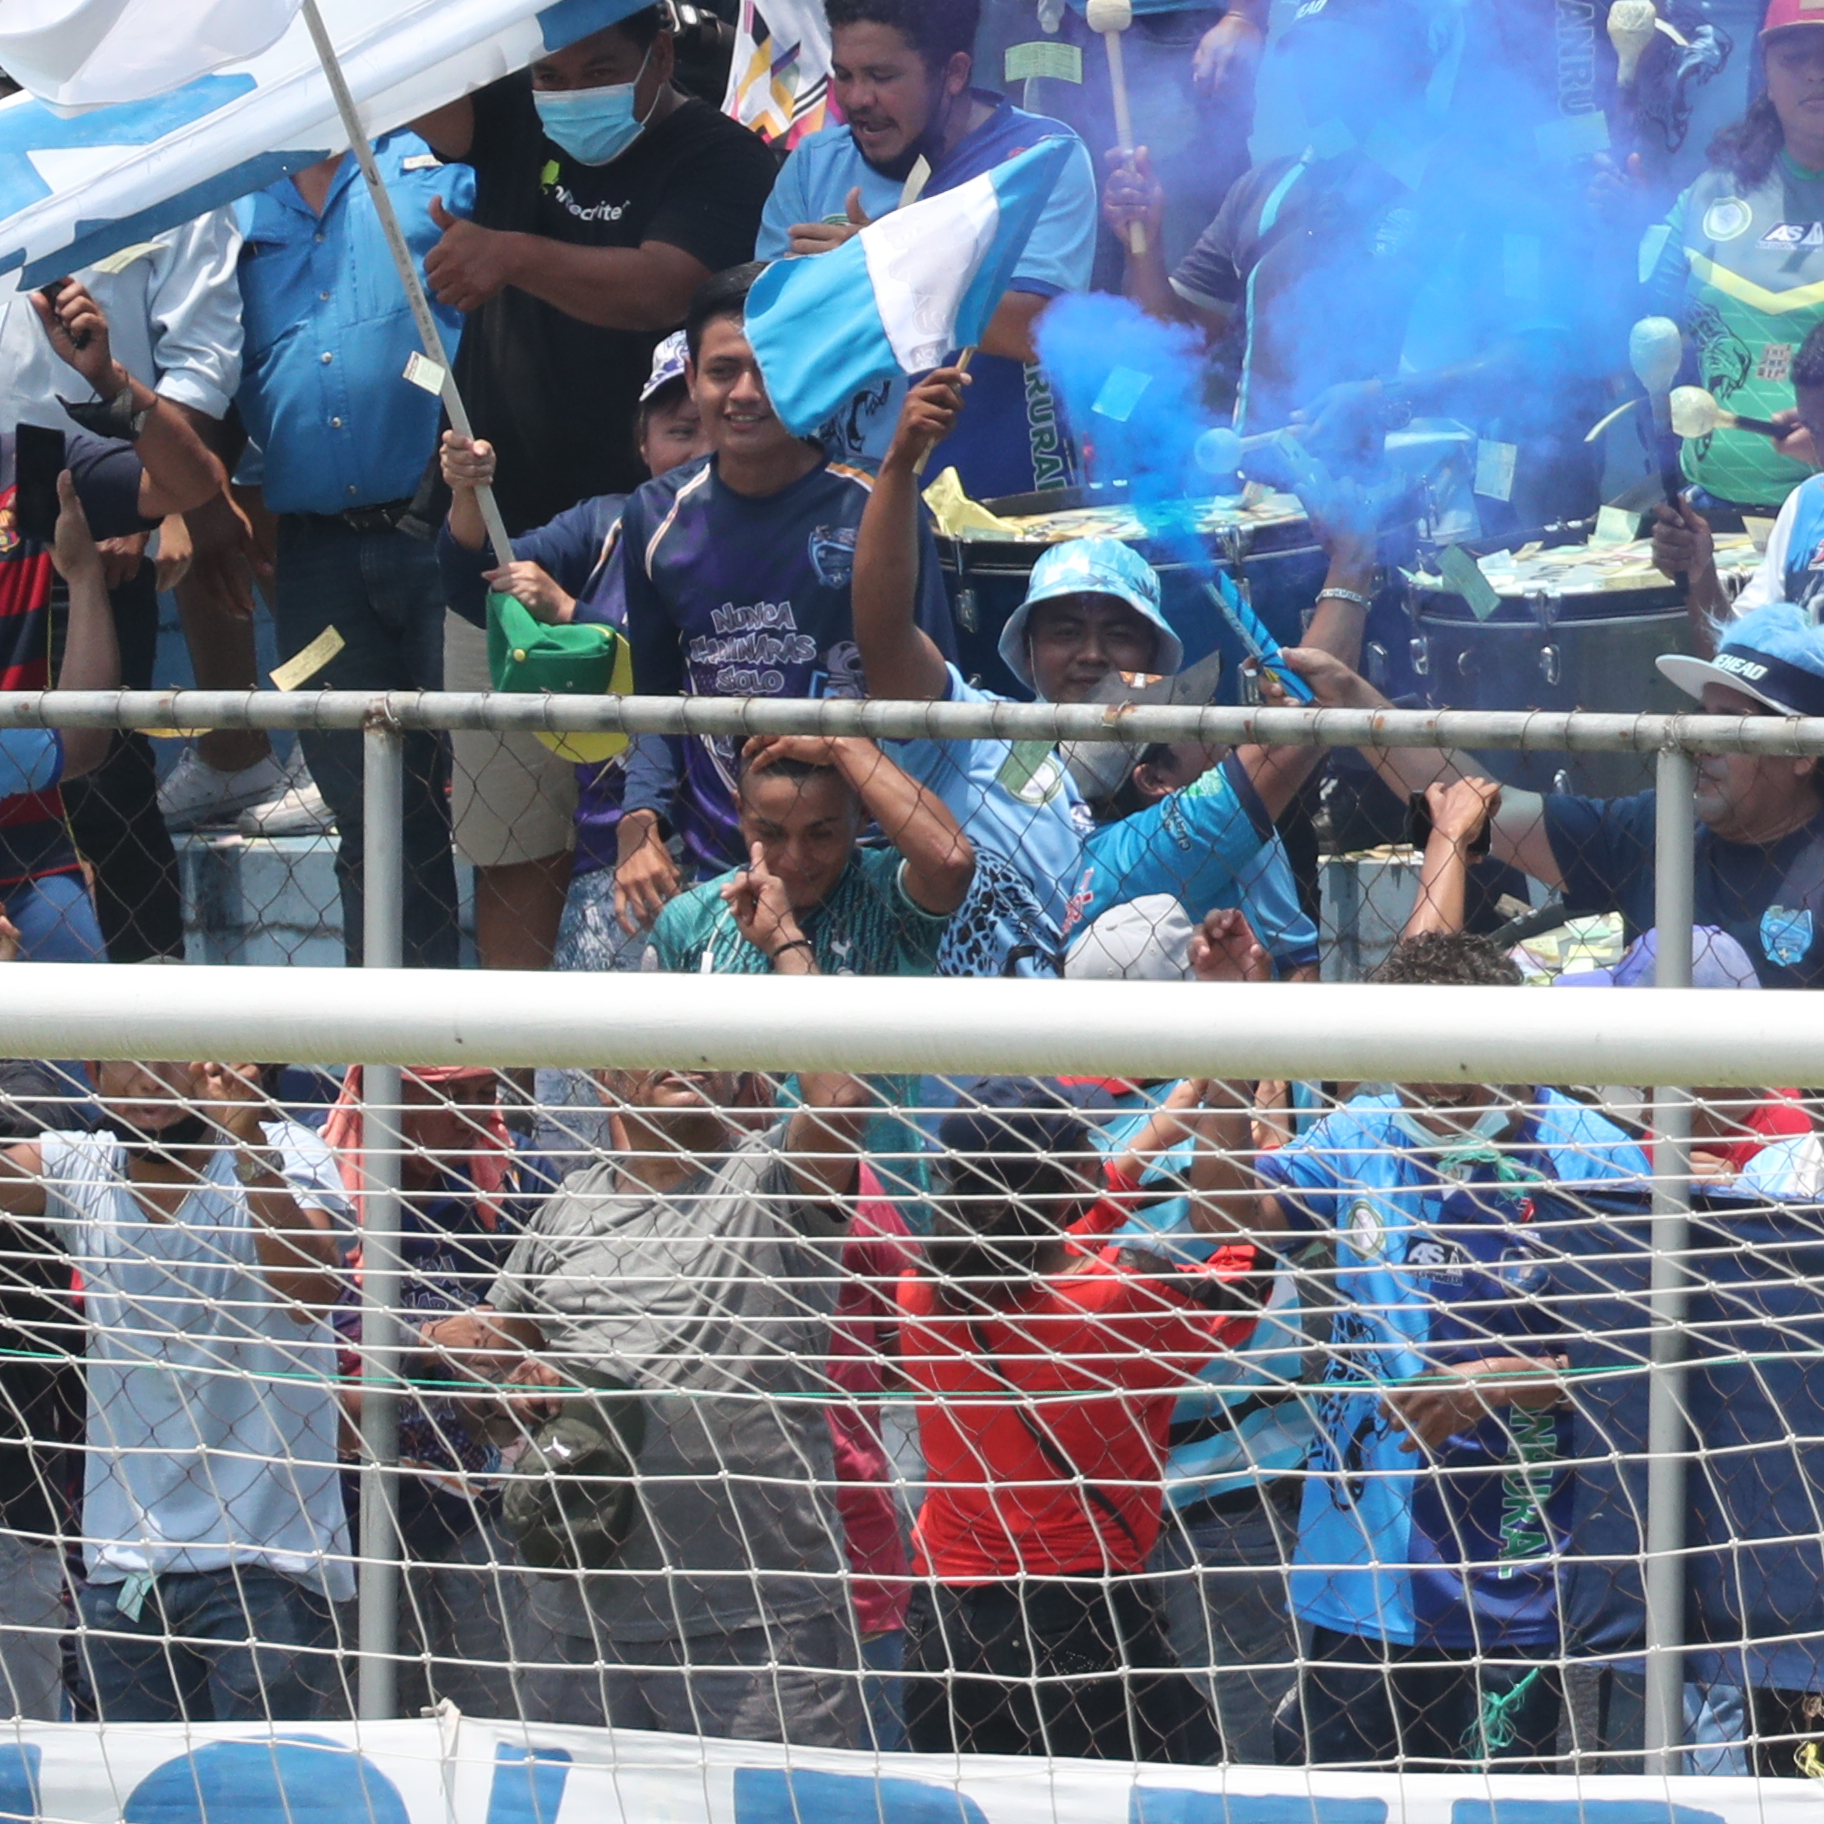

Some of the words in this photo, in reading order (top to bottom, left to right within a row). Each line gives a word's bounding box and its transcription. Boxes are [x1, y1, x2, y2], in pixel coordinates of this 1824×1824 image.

[1764, 221, 1824, 246] ASA
[710, 600, 799, 634] NUNCA
[690, 632, 819, 665] CAMINARAS
[715, 669, 786, 694] SOLO
